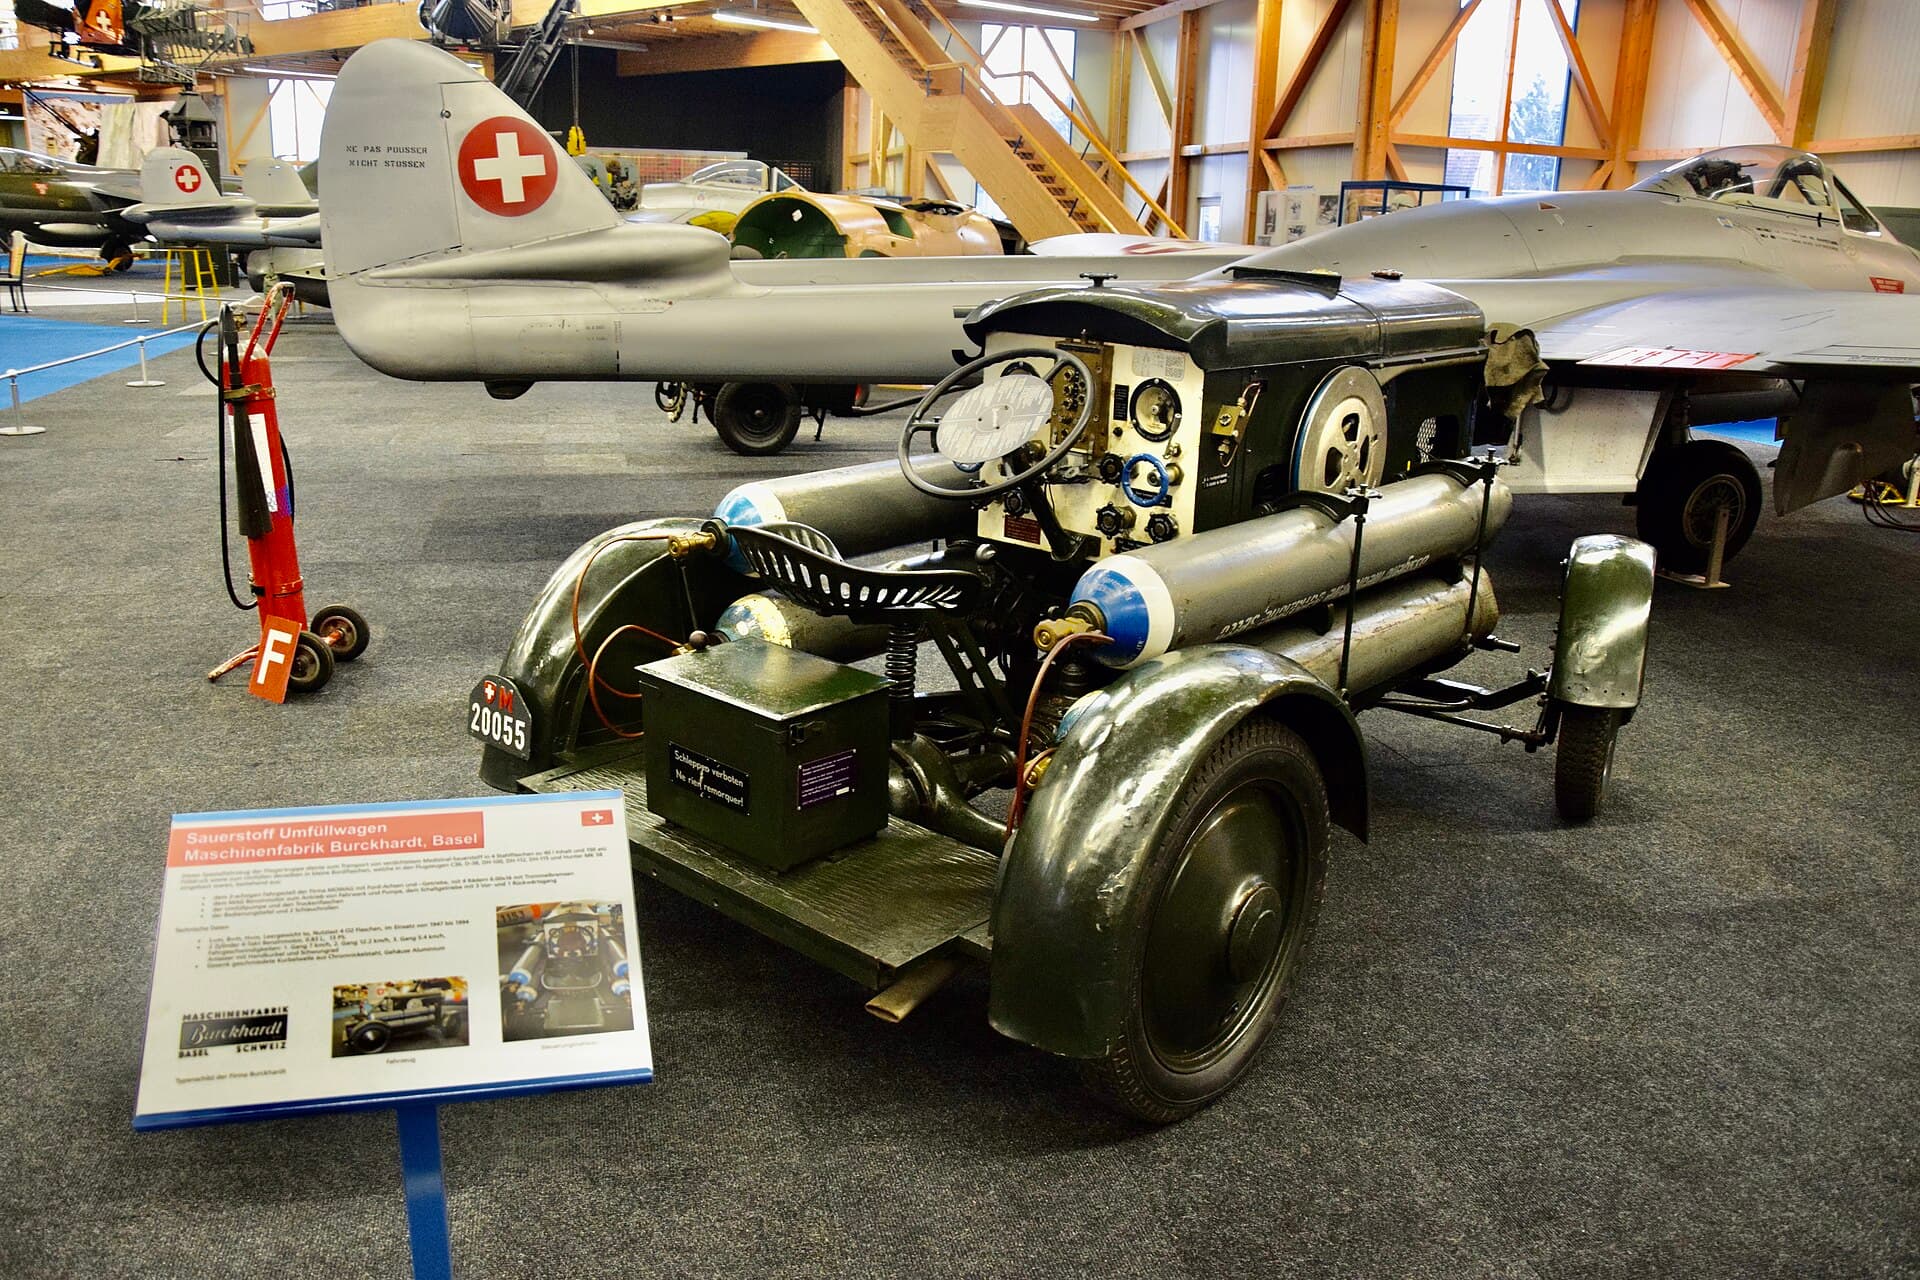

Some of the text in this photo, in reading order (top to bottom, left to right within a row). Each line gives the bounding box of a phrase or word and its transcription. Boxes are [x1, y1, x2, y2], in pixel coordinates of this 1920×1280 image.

[363, 146, 382, 154] PAS
[386, 146, 428, 154] POUSSER
[350, 159, 426, 168] NICHT STOSSEN
[256, 628, 293, 685] F
[498, 686, 514, 714] M
[470, 702, 526, 750] 20055
[712, 769, 744, 788] verboten
[186, 822, 388, 844] Sauerstoff Umfüllwagen
[184, 833, 478, 862] Maschinenfabrik Burckhardt, Basel
[182, 1006, 288, 1021] MASCHINENFABRIK
[191, 1021, 282, 1045] Burckhardt
[178, 1042, 286, 1058] BASEL SCHWEIZ
